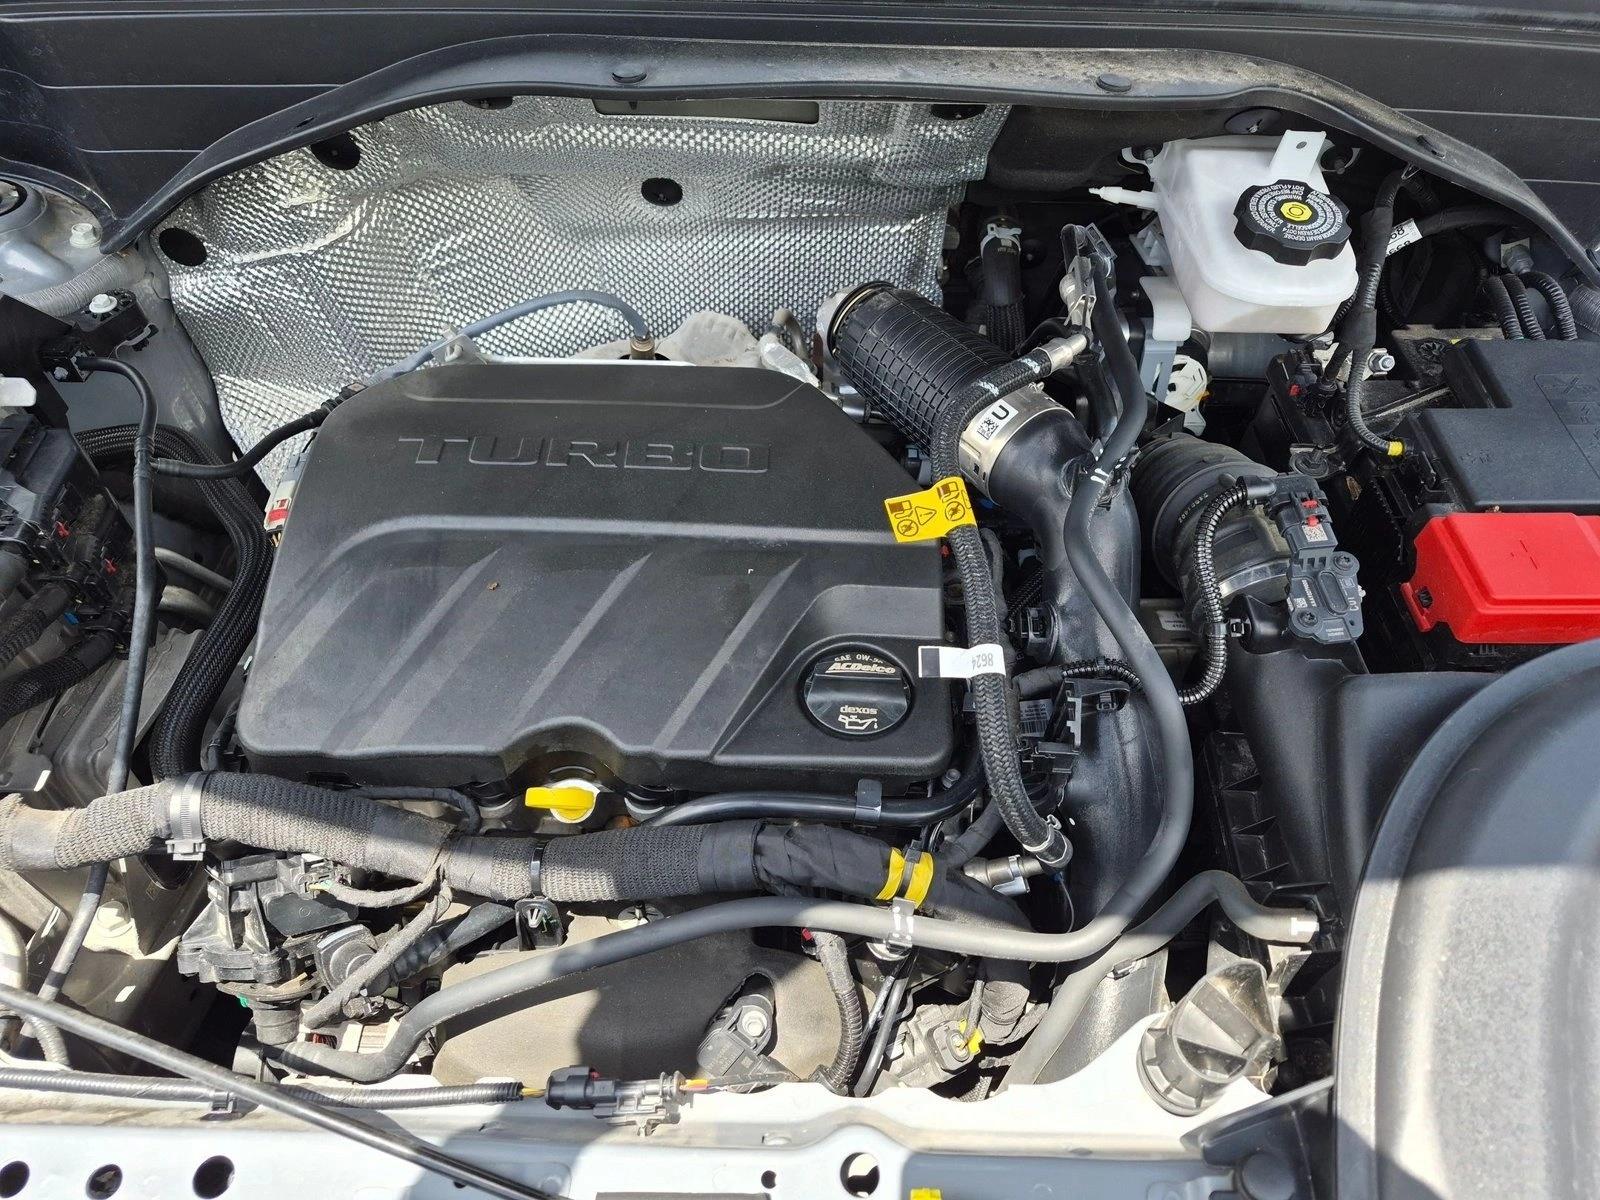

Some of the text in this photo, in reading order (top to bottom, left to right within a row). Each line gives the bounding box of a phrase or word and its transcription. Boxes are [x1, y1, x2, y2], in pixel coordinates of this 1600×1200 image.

[991, 405, 1009, 420] U
[398, 435, 772, 474] TURBO
[825, 662, 897, 674] ACDelco
[839, 704, 878, 715] dexos
